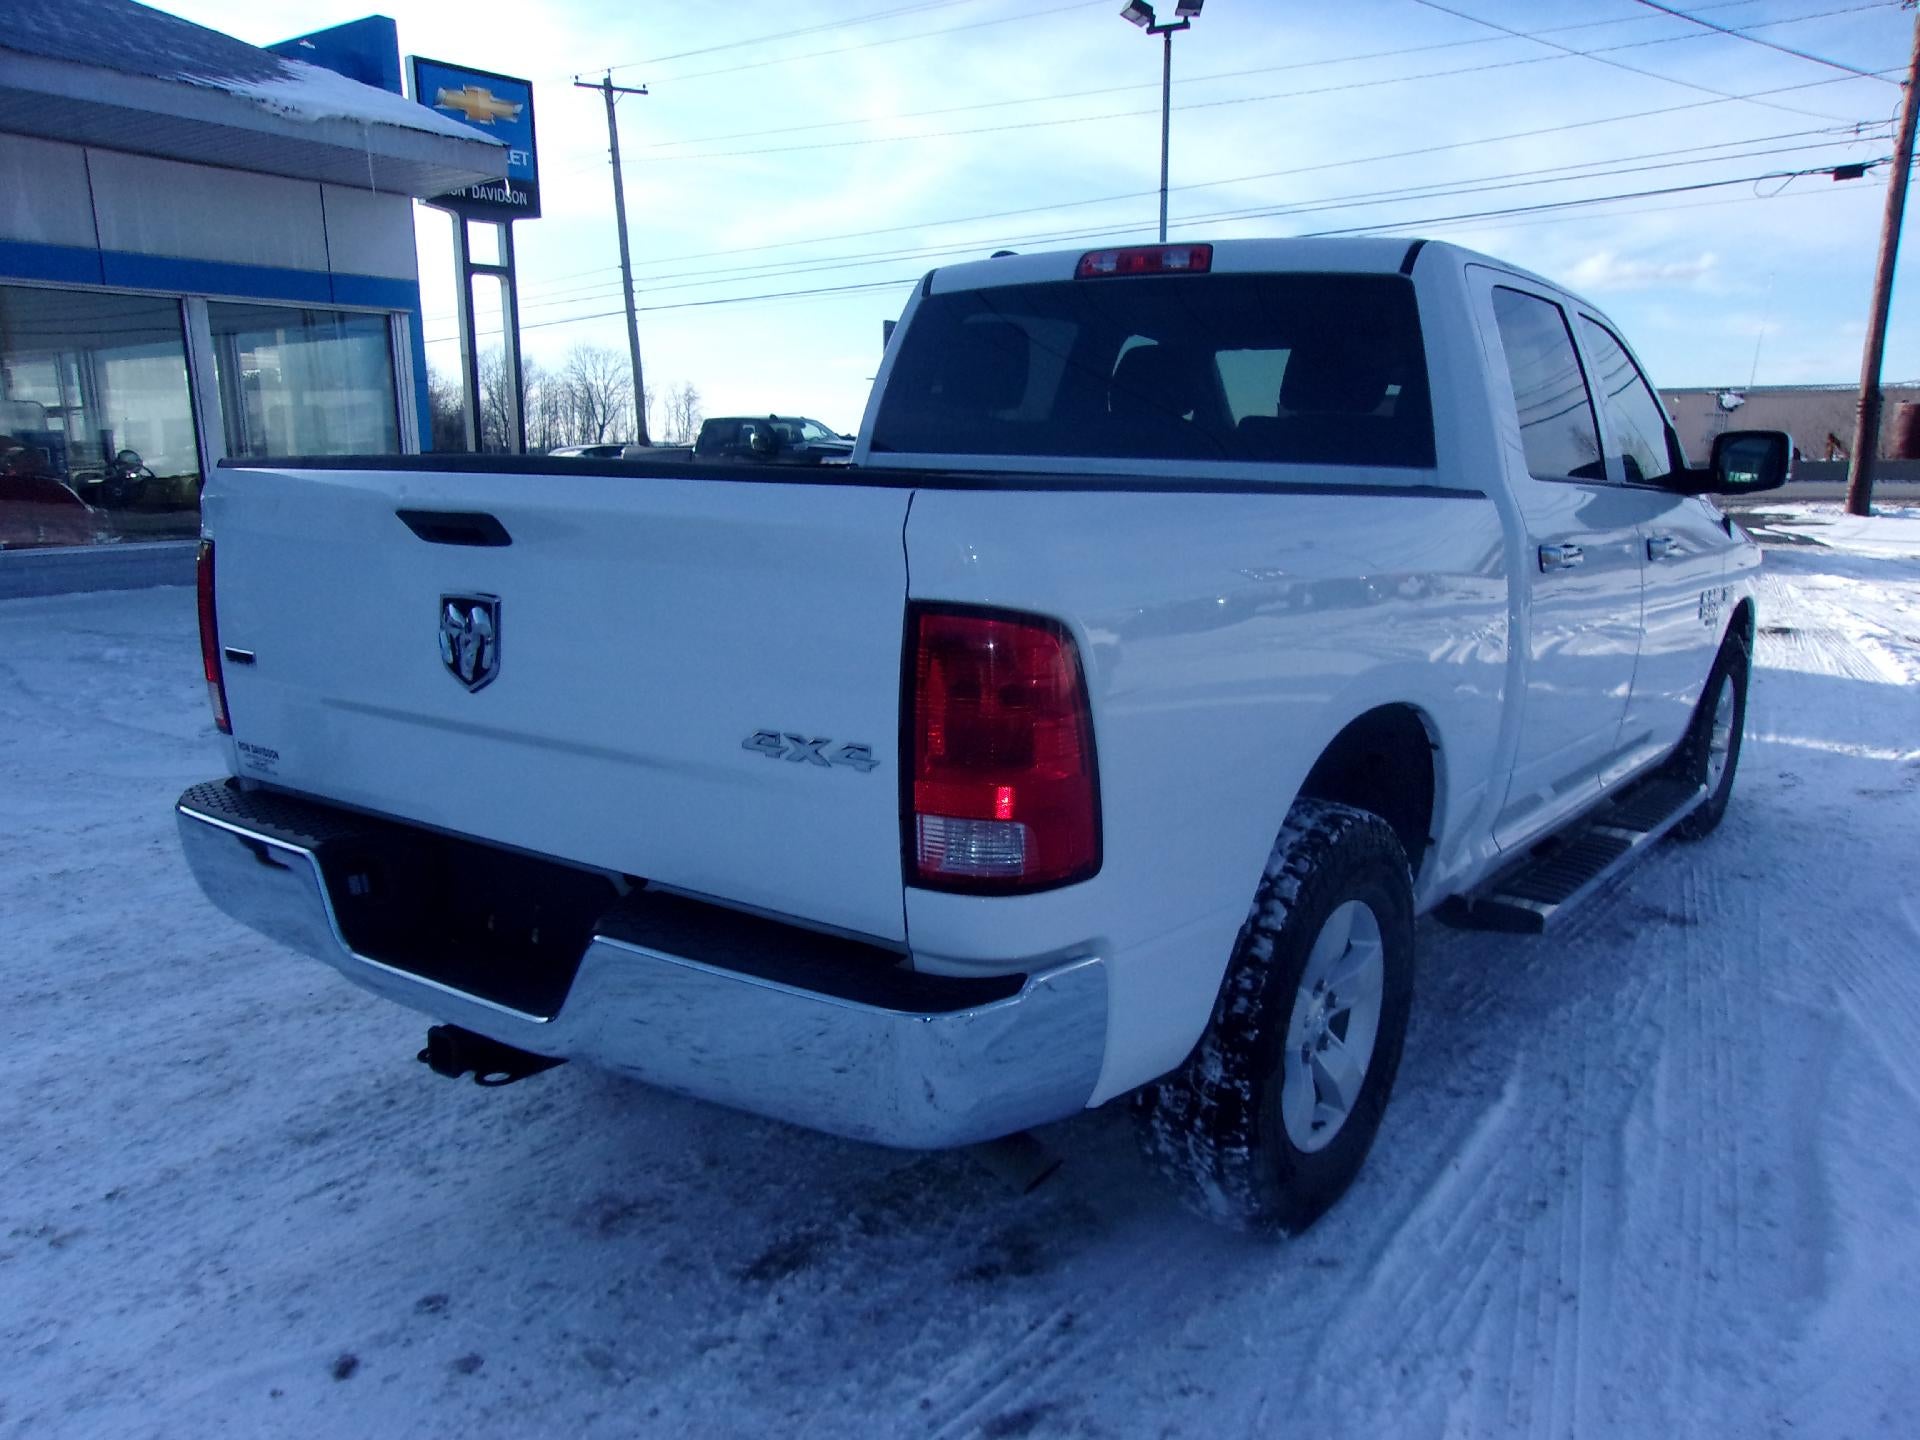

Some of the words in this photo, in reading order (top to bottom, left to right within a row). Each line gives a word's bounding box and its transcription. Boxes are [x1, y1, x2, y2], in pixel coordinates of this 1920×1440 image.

[507, 149, 529, 166] ET
[448, 187, 466, 197] ON
[472, 185, 528, 205] DAVIDSON
